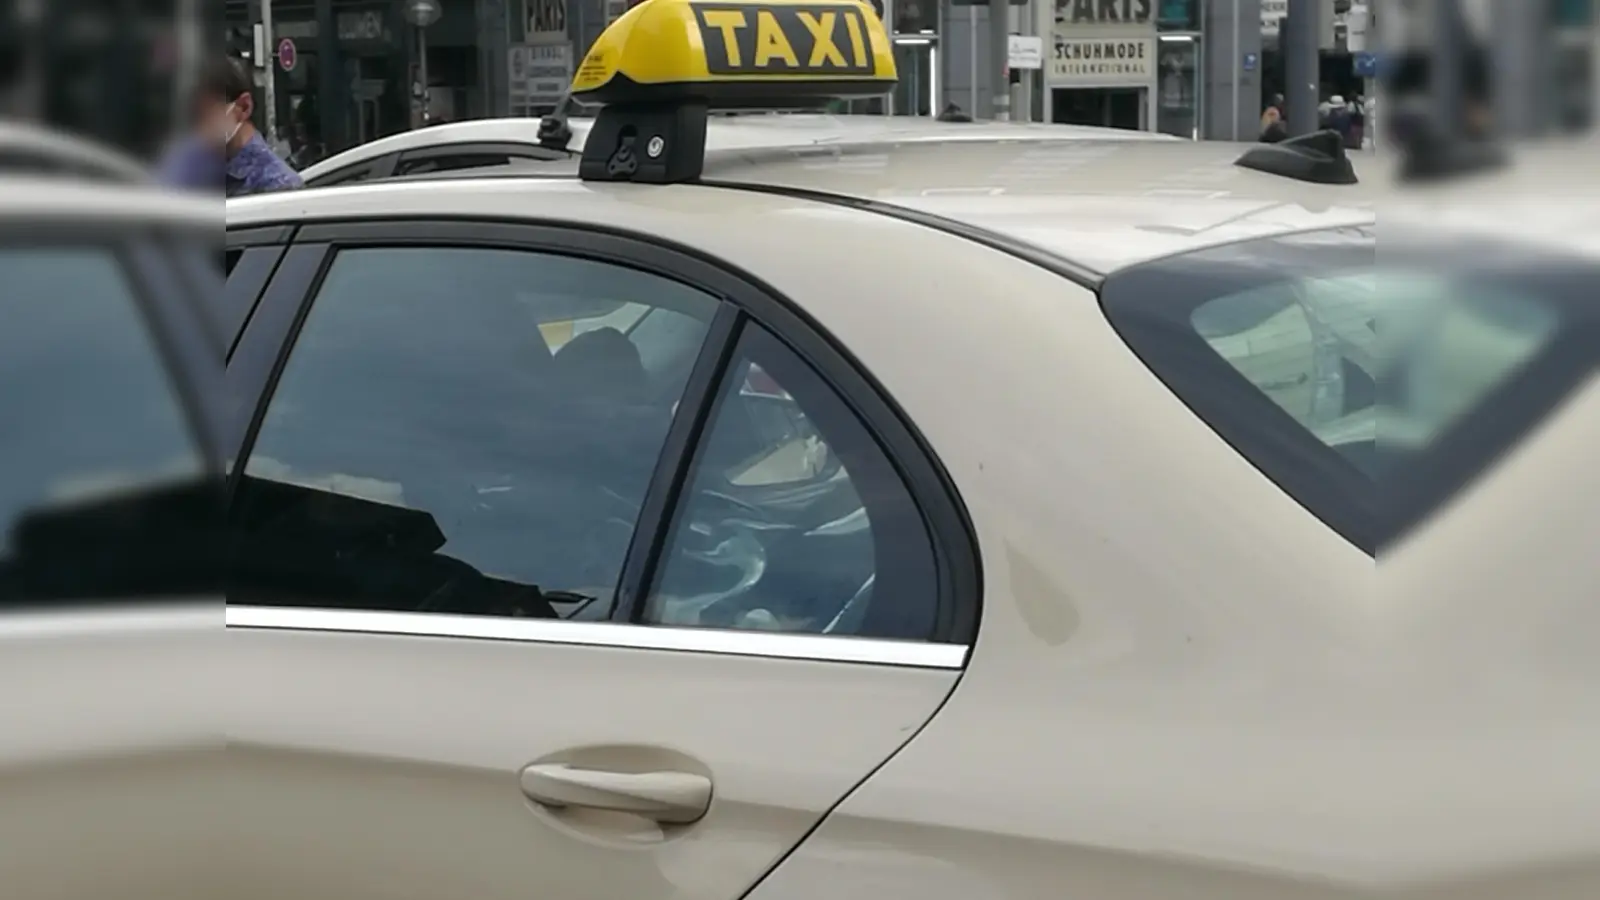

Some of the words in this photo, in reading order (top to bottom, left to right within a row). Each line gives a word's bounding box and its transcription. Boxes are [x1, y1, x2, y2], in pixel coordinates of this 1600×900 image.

[526, 0, 565, 32] PARIS
[1054, 0, 1151, 24] PARIS
[702, 10, 868, 67] TAXI
[1054, 42, 1145, 59] SCHUHMODE
[1054, 63, 1146, 75] INTERNATIONAL
